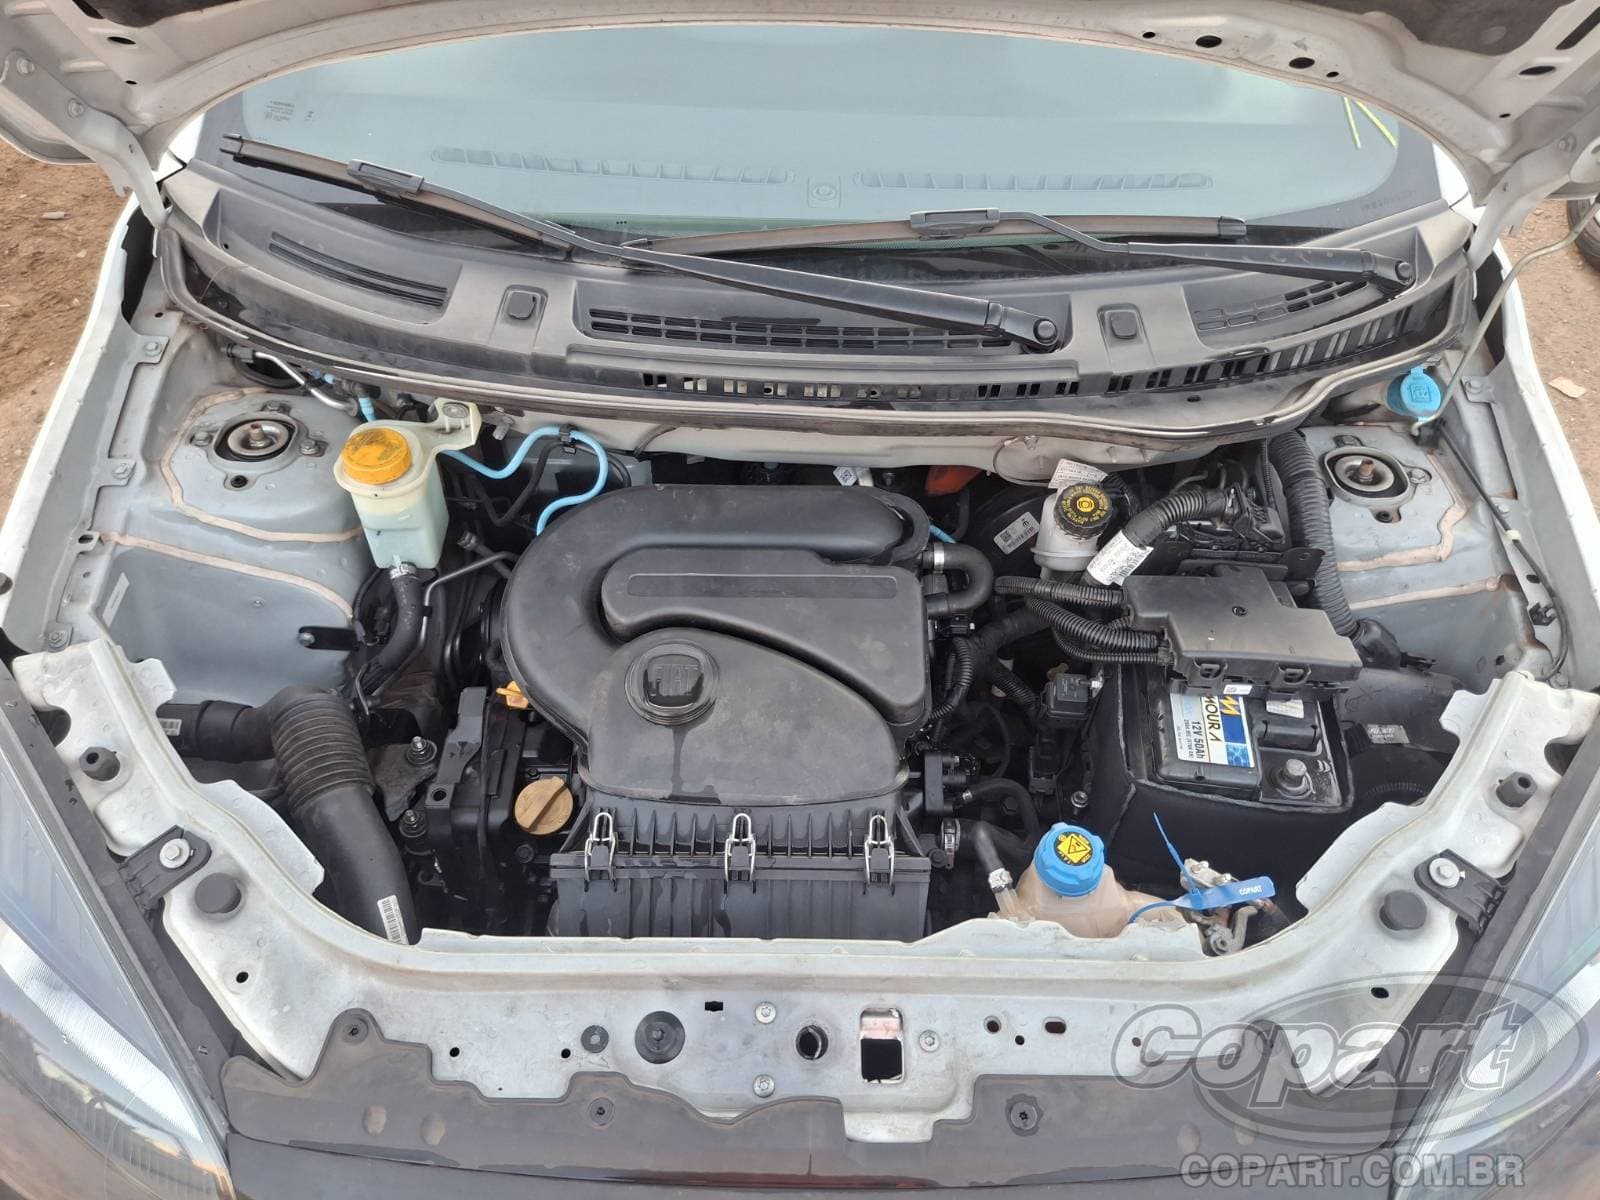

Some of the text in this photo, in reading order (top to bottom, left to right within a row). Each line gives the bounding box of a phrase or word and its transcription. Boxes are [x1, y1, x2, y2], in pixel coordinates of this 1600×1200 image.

[655, 663, 699, 697] FIAT
[1191, 721, 1206, 759] 12V 50Ah
